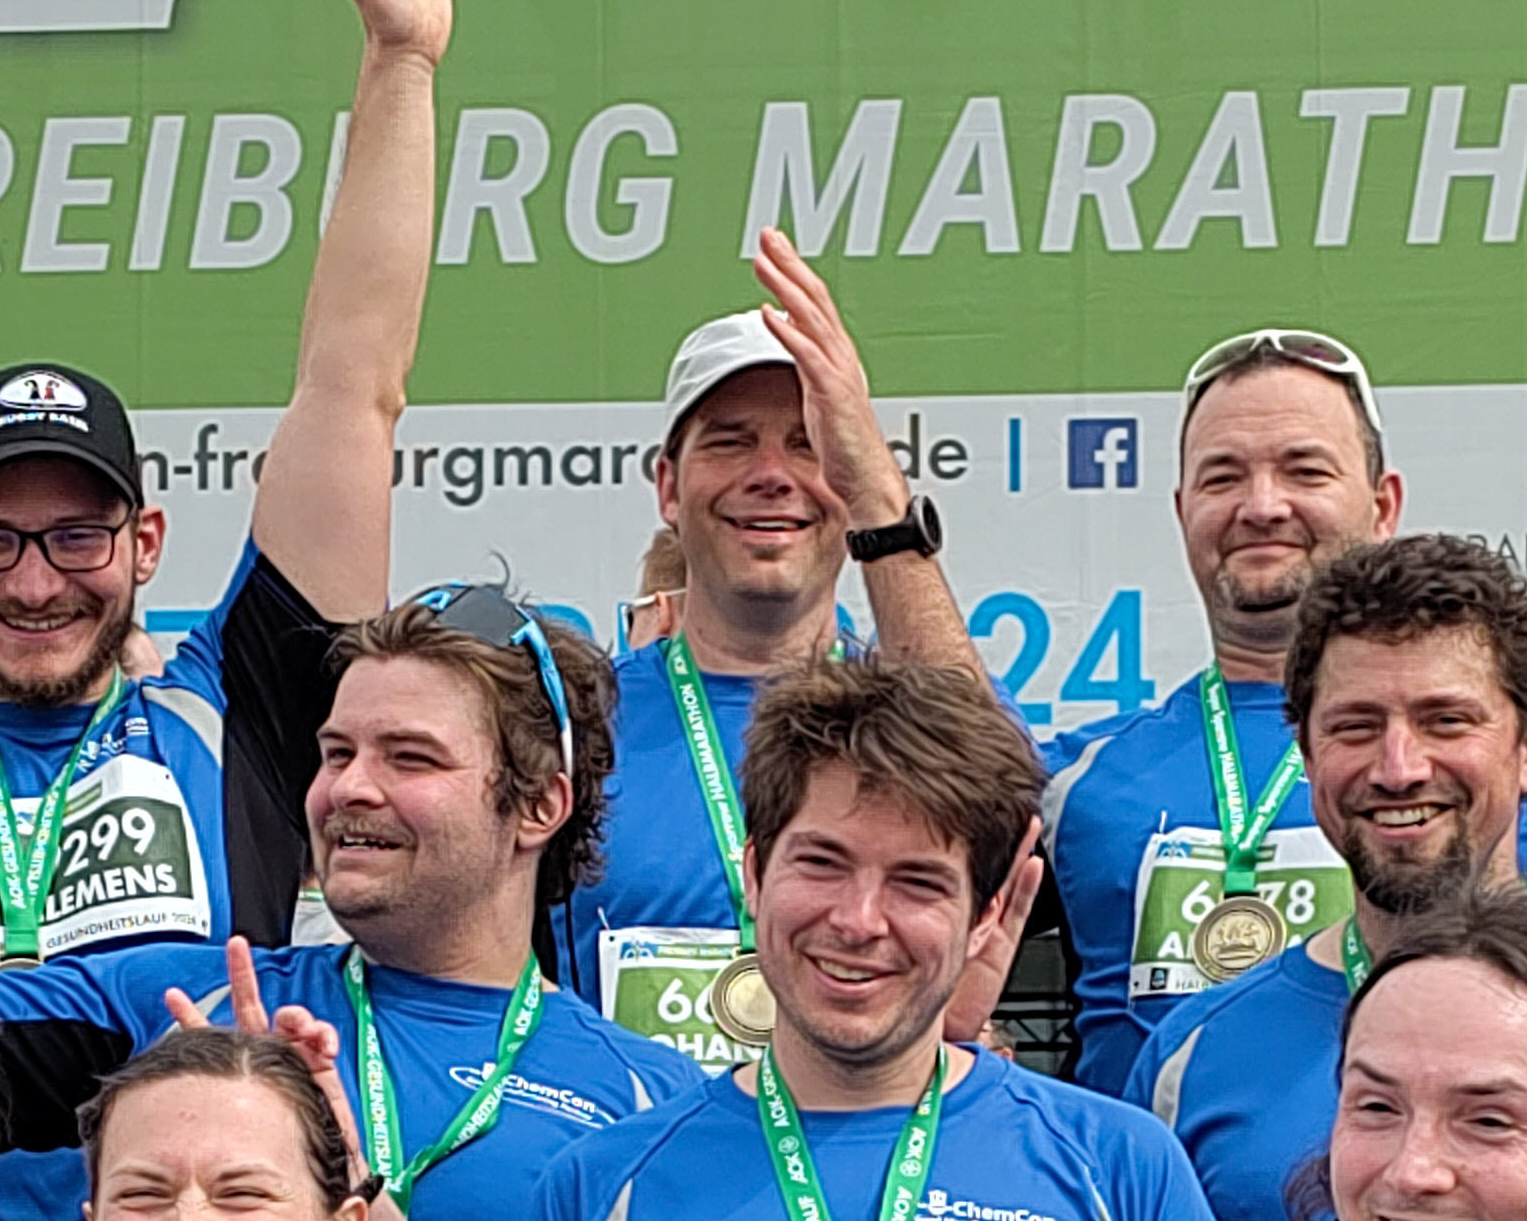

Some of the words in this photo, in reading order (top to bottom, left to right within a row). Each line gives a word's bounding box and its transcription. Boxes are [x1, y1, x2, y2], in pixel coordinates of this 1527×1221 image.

[680, 683, 726, 801] HALBMARATHON
[60, 808, 156, 878] 299
[41, 864, 178, 922] LEMENS
[1181, 879, 1315, 924] 678
[46, 912, 168, 950] GESUNDHEITSLAUF
[905, 1126, 927, 1161] AOK
[786, 1155, 808, 1185] AOK
